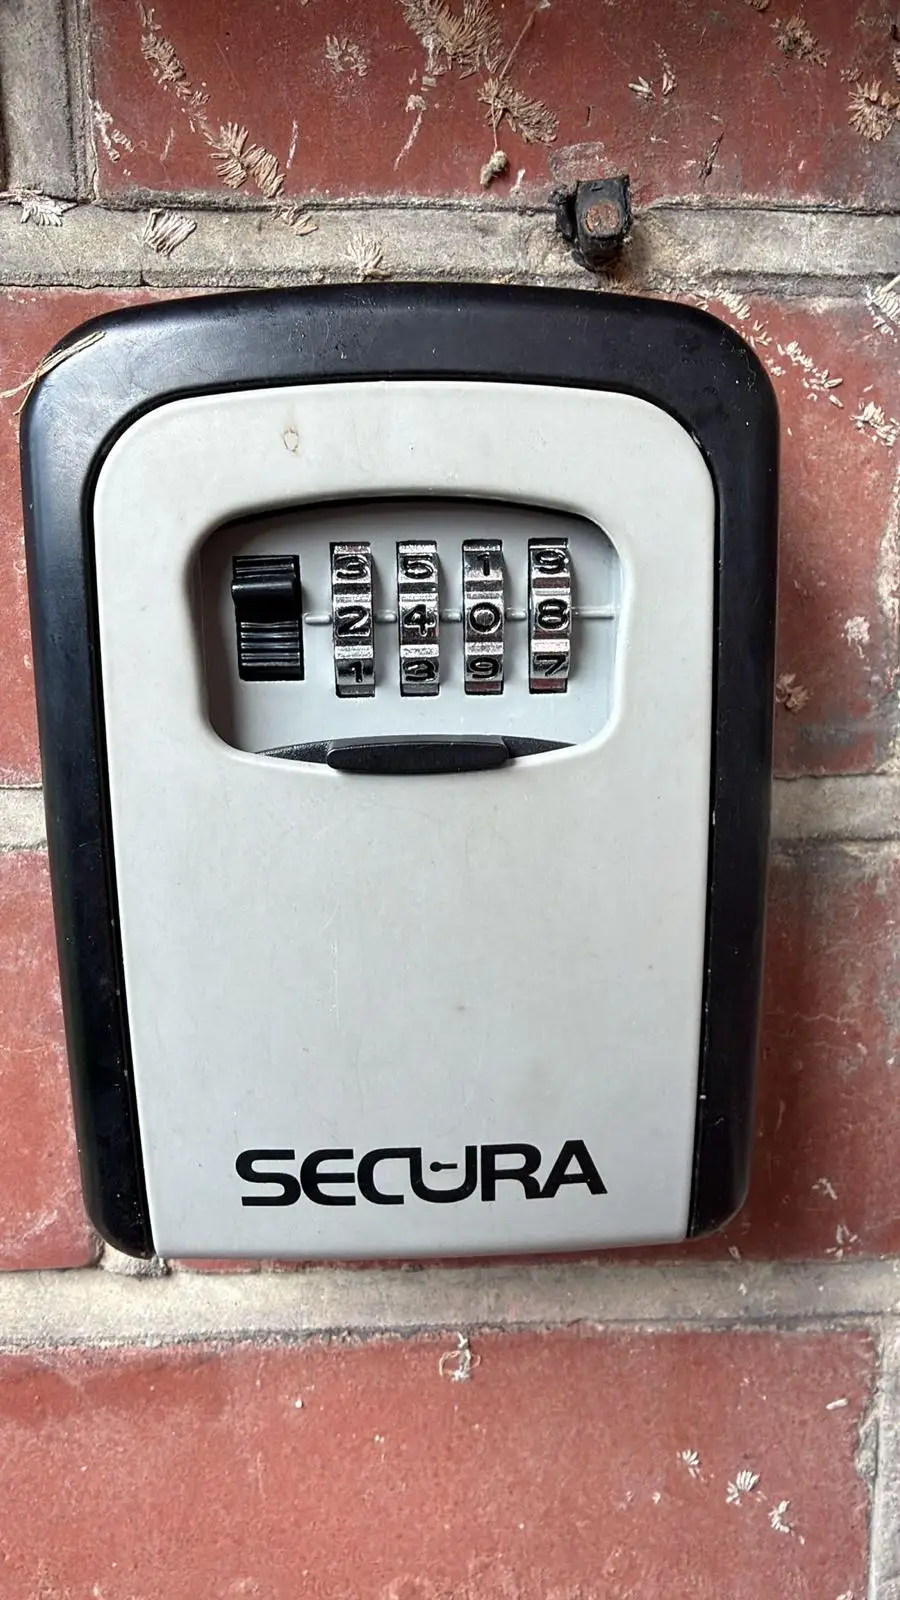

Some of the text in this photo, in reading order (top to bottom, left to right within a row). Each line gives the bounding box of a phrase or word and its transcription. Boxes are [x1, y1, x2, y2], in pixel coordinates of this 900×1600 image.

[335, 548, 568, 580] 3 5 1 9
[336, 598, 570, 638] 2 4 0 8
[349, 654, 568, 683] 1 3 9 7
[235, 1139, 608, 1206] SECURA
